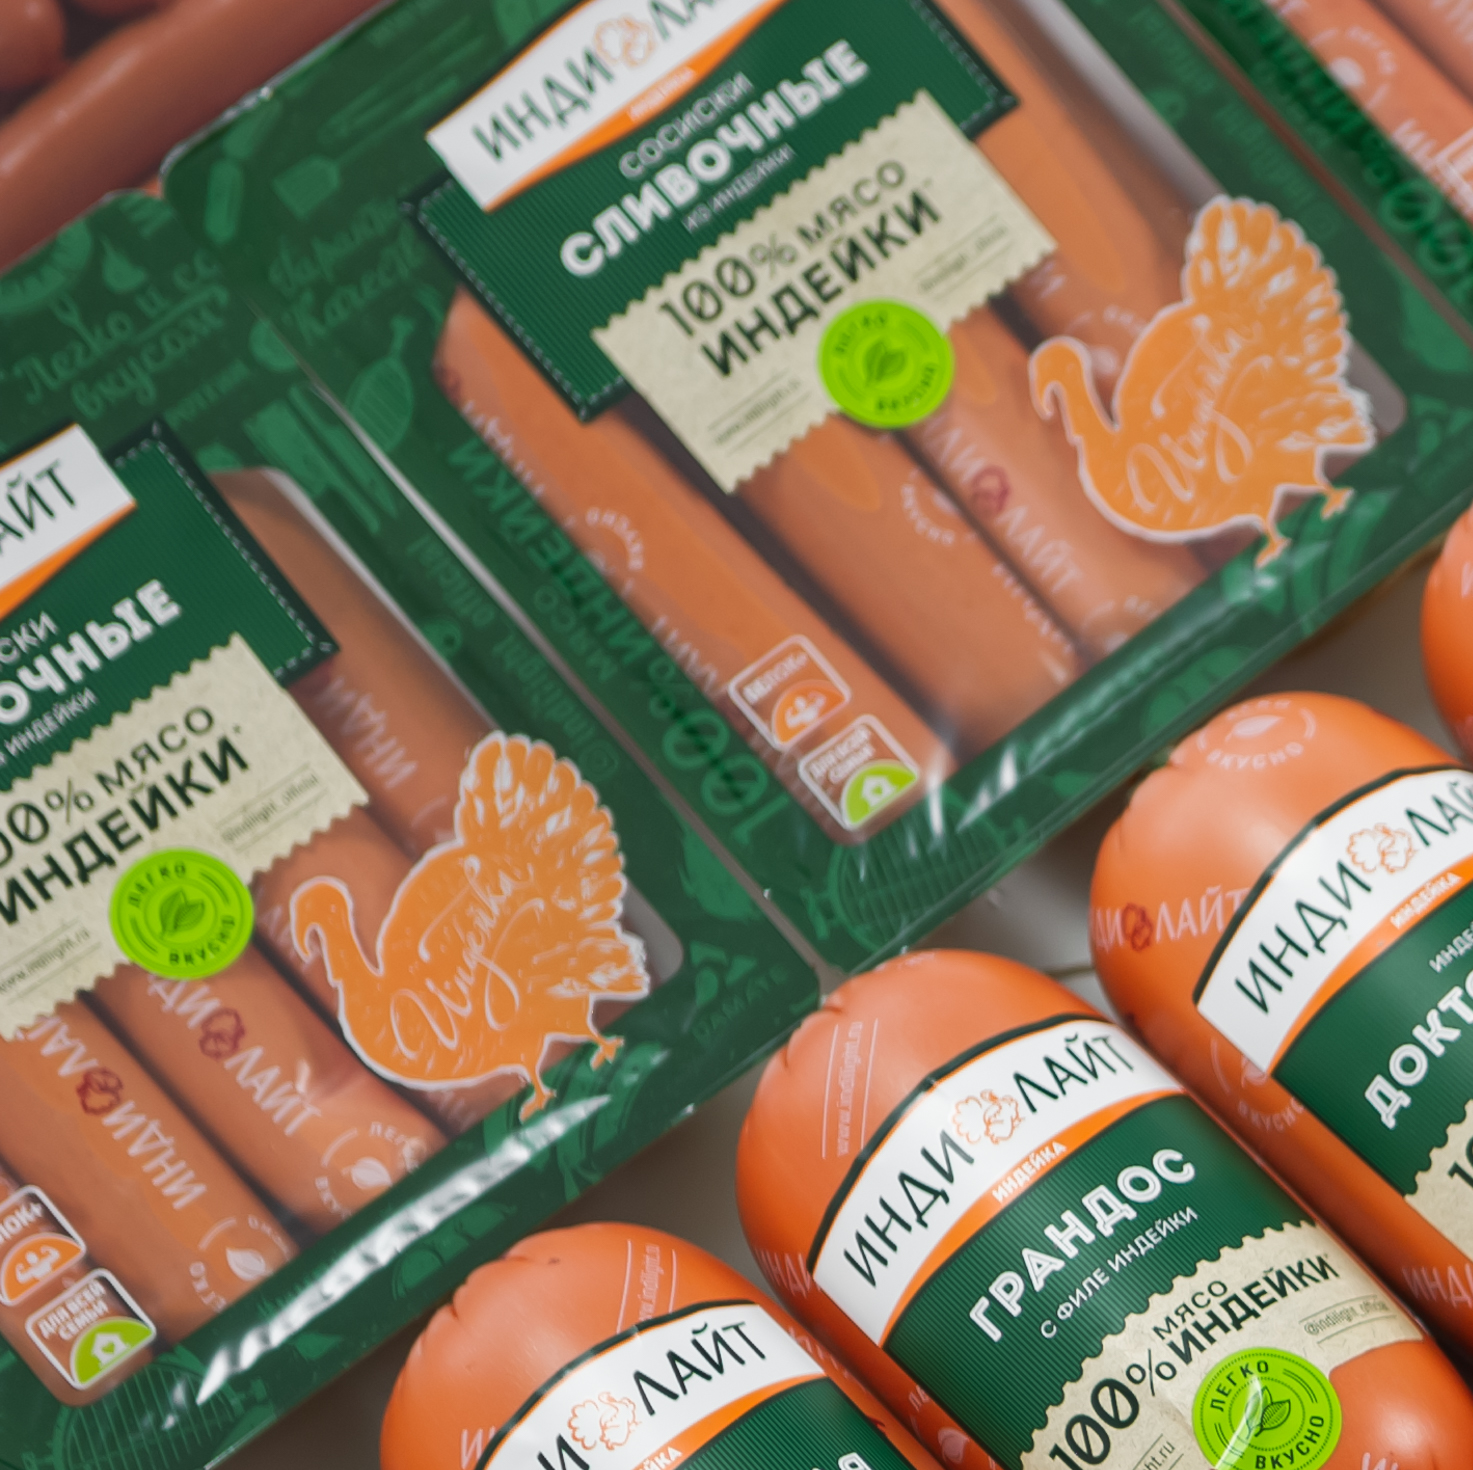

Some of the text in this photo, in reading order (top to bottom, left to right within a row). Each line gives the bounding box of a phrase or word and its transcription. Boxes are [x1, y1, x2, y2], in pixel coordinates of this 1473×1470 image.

[560, 39, 869, 277] СЛИВОЧНЫЕ
[618, 71, 754, 178] СОСИСКИ
[657, 160, 908, 338] 100% МЯСО
[702, 191, 942, 376] ИНДЕЙКИ
[0, 578, 182, 724] ОЧНЫЕ
[100, 706, 214, 796] МЯСО
[0, 736, 249, 925] ИНДЕЙКИ
[0, 1203, 44, 1244] ЛОК+
[969, 1149, 1196, 1342] ГРАНДОС
[1057, 1269, 1110, 1324] ФИЛЕ
[1108, 1207, 1199, 1275] ИНДЕЙКИ
[1169, 1253, 1340, 1365] ИНДЕЙКИ
